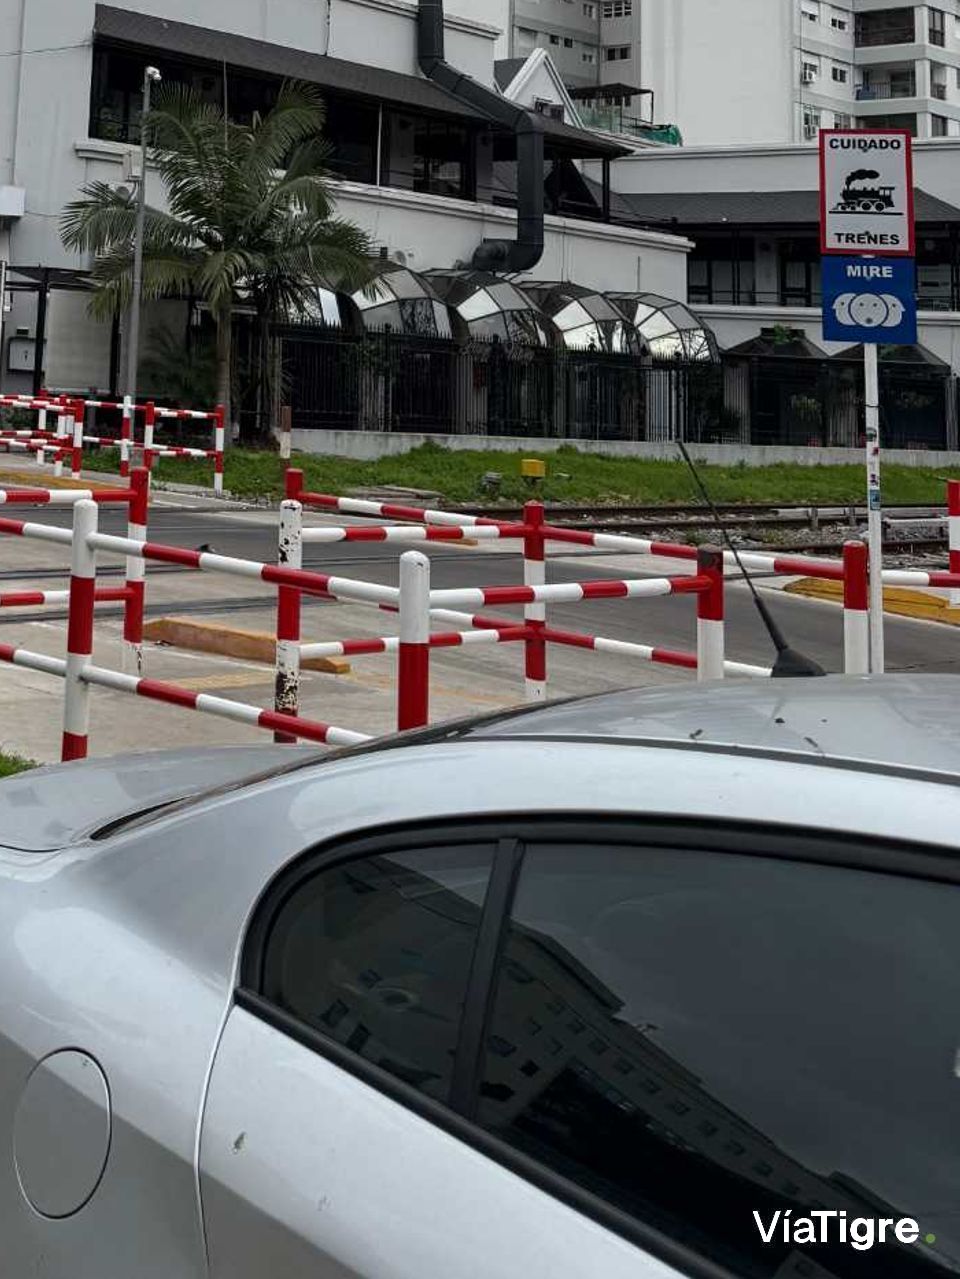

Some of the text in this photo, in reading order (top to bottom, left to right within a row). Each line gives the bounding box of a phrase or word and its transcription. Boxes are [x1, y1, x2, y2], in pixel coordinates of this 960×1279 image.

[829, 138, 901, 150] CUIDADO
[834, 232, 900, 245] TRENES
[847, 265, 893, 278] MIRE
